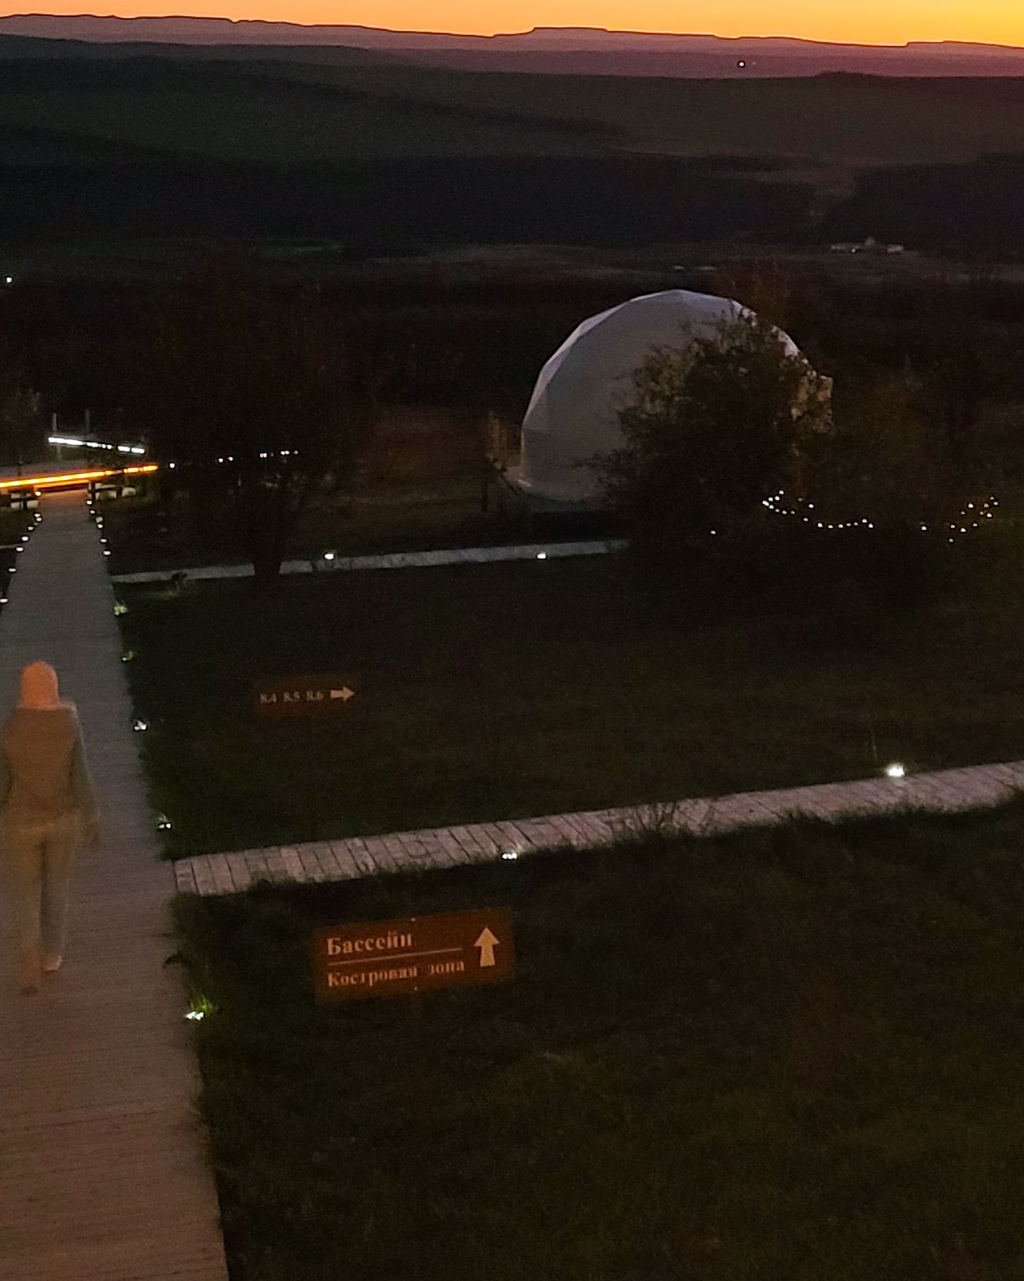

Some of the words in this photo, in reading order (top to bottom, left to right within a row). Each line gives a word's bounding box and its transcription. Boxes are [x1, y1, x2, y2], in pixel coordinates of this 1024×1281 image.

[327, 930, 412, 956] Бассейн
[327, 965, 418, 987] Костровая
[429, 959, 466, 975] зона
